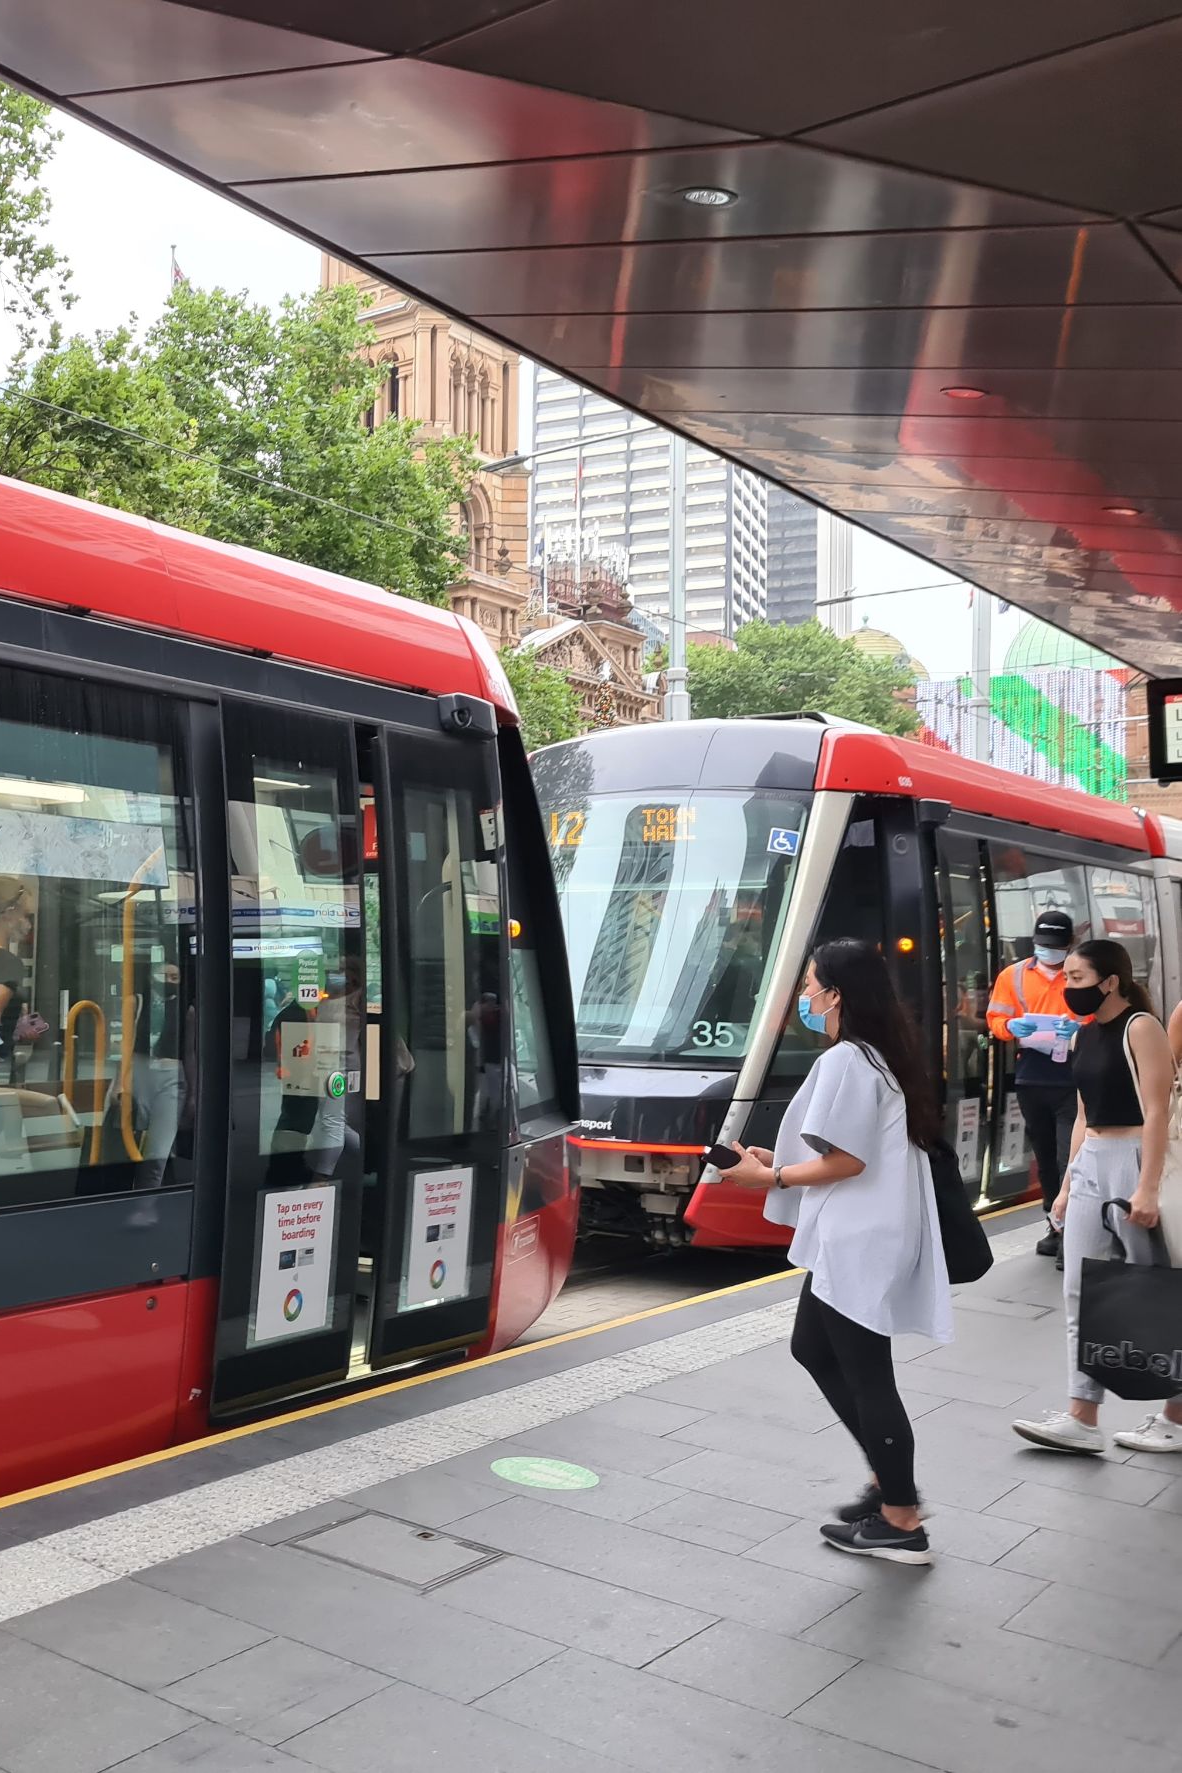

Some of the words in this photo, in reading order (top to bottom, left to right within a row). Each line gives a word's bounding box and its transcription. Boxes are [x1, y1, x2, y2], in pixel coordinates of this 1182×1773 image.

[642, 806, 697, 825] TOWN
[549, 810, 587, 847] L2
[643, 824, 697, 842] HALL
[300, 988, 318, 998] 173
[691, 1020, 736, 1048] 35
[277, 1203, 290, 1215] Tap
[292, 1203, 302, 1212] on
[303, 1200, 324, 1211] every
[278, 1216, 295, 1228] time
[296, 1213, 321, 1225] before
[281, 1227, 316, 1240] boarding
